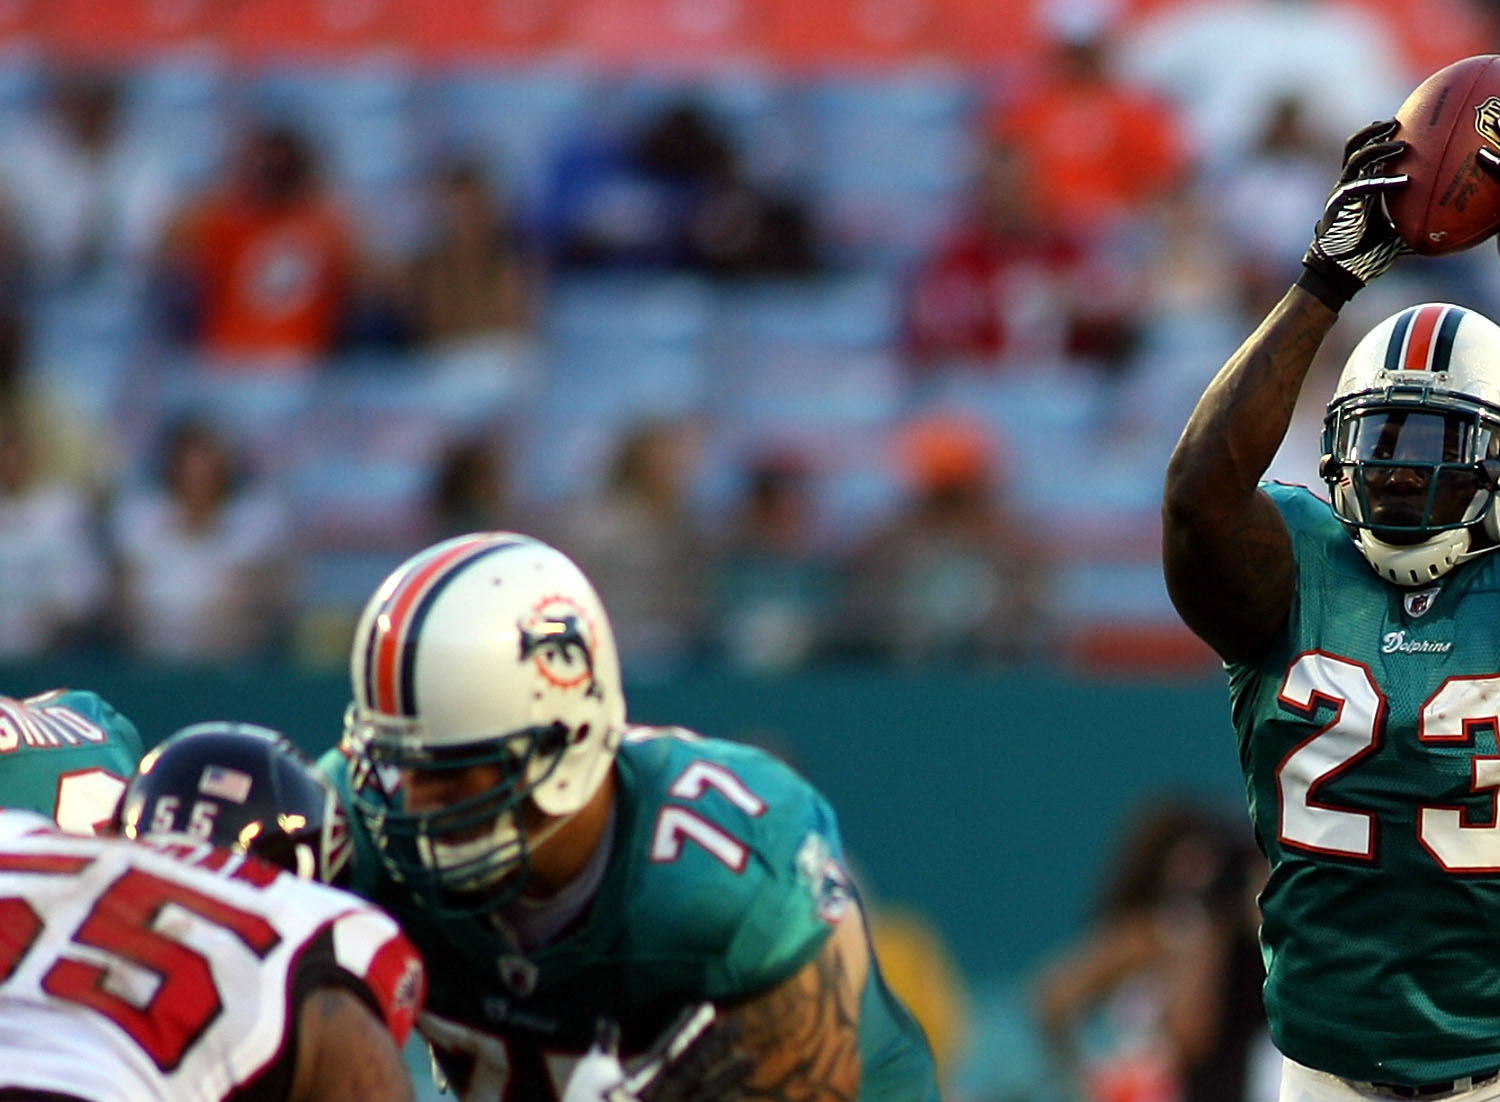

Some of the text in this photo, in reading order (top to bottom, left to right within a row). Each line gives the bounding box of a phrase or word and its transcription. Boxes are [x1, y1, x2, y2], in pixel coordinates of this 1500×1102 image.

[1382, 630, 1452, 654] Dolphins
[151, 795, 219, 837] 55
[650, 758, 769, 876] 77
